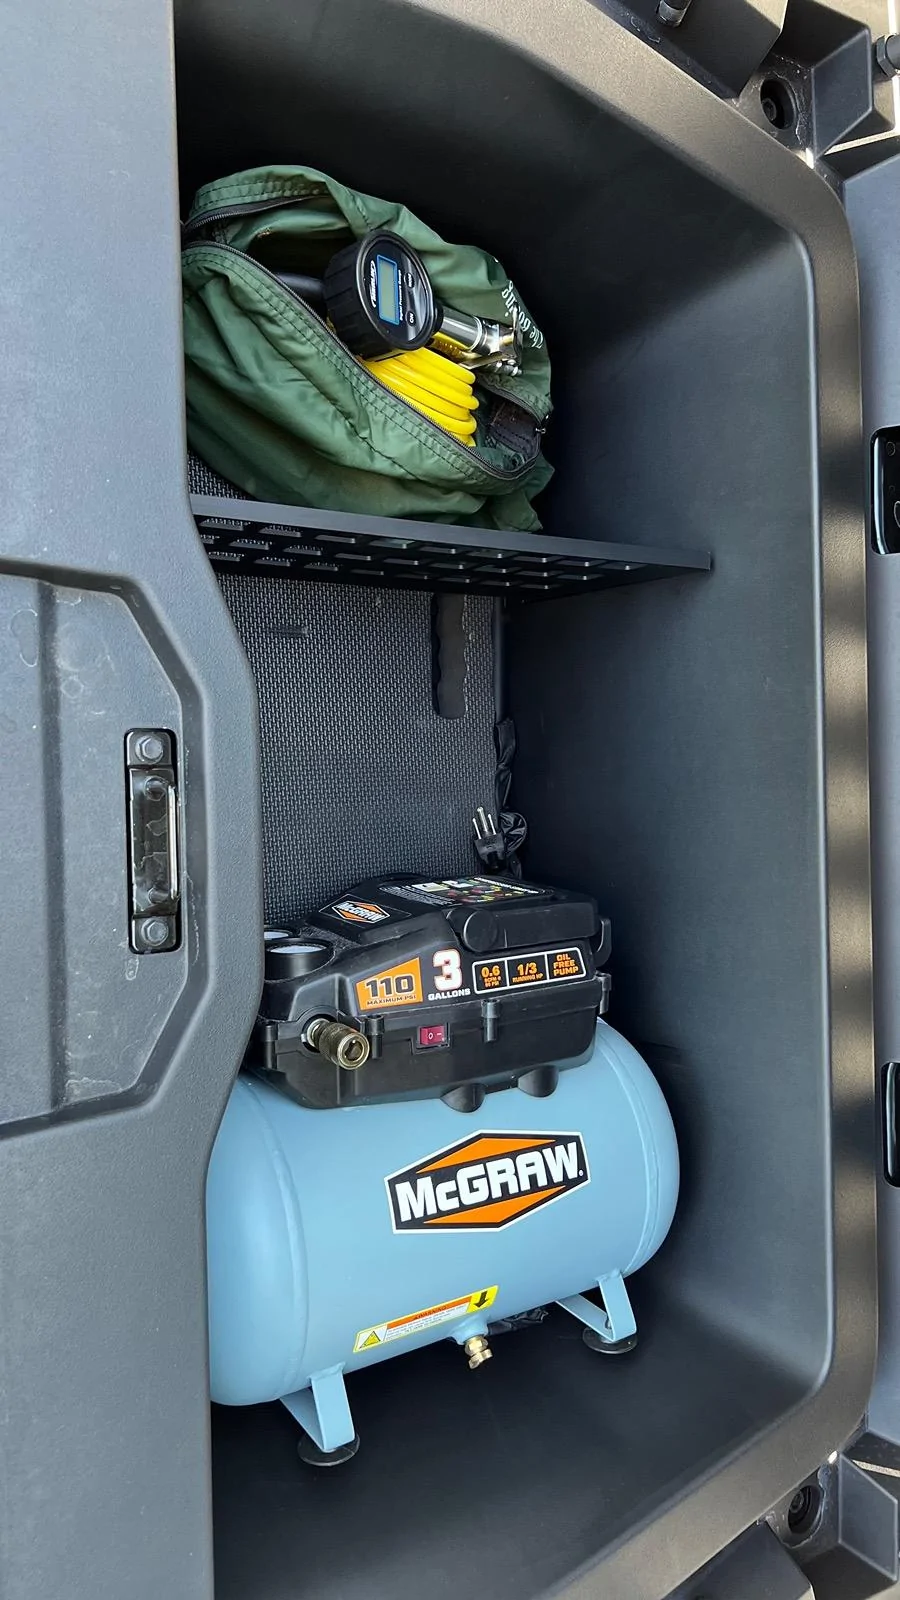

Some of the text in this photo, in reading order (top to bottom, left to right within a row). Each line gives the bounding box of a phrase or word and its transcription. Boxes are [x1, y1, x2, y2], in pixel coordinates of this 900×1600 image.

[409, 312, 414, 324] ON
[529, 325, 544, 349] The
[556, 953, 571, 961] OIL
[432, 948, 463, 991] 3
[517, 962, 537, 976] 1/3
[553, 959, 576, 969] FREE
[481, 965, 500, 978] 0.6
[553, 966, 579, 977] PUMP
[512, 974, 536, 983] RUNNING
[365, 973, 415, 998] 110
[366, 996, 403, 1006] MAXIMUM
[427, 988, 471, 1001] GALLONS
[395, 1142, 579, 1223] McGRAW
